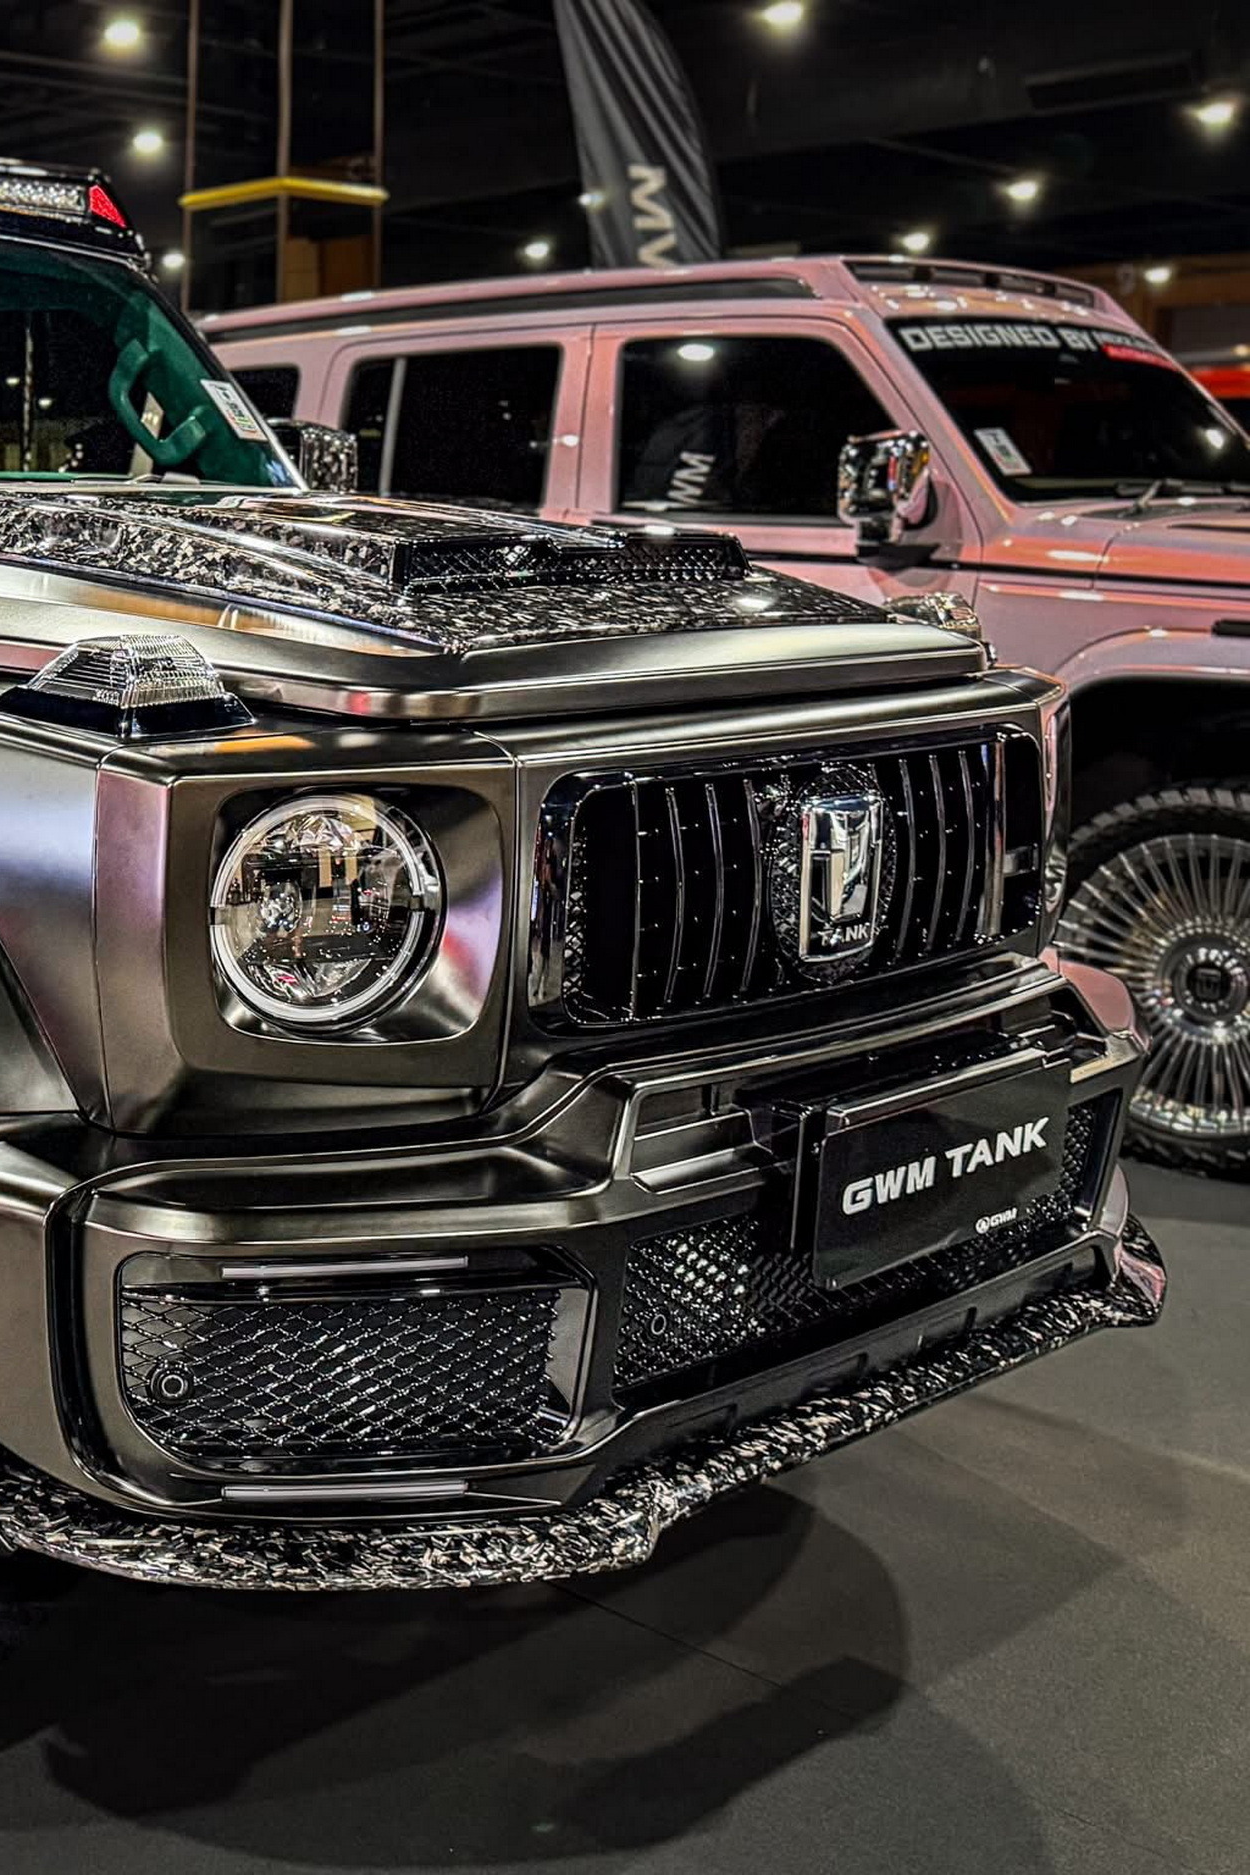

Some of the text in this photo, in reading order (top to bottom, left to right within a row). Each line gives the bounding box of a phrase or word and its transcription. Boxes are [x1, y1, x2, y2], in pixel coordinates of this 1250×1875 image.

[899, 324, 1061, 351] DESIGNED
[1057, 327, 1098, 351] BY
[817, 921, 871, 947] TANK
[842, 1116, 1049, 1215] GWM TANK
[990, 1207, 1018, 1227] GWM
